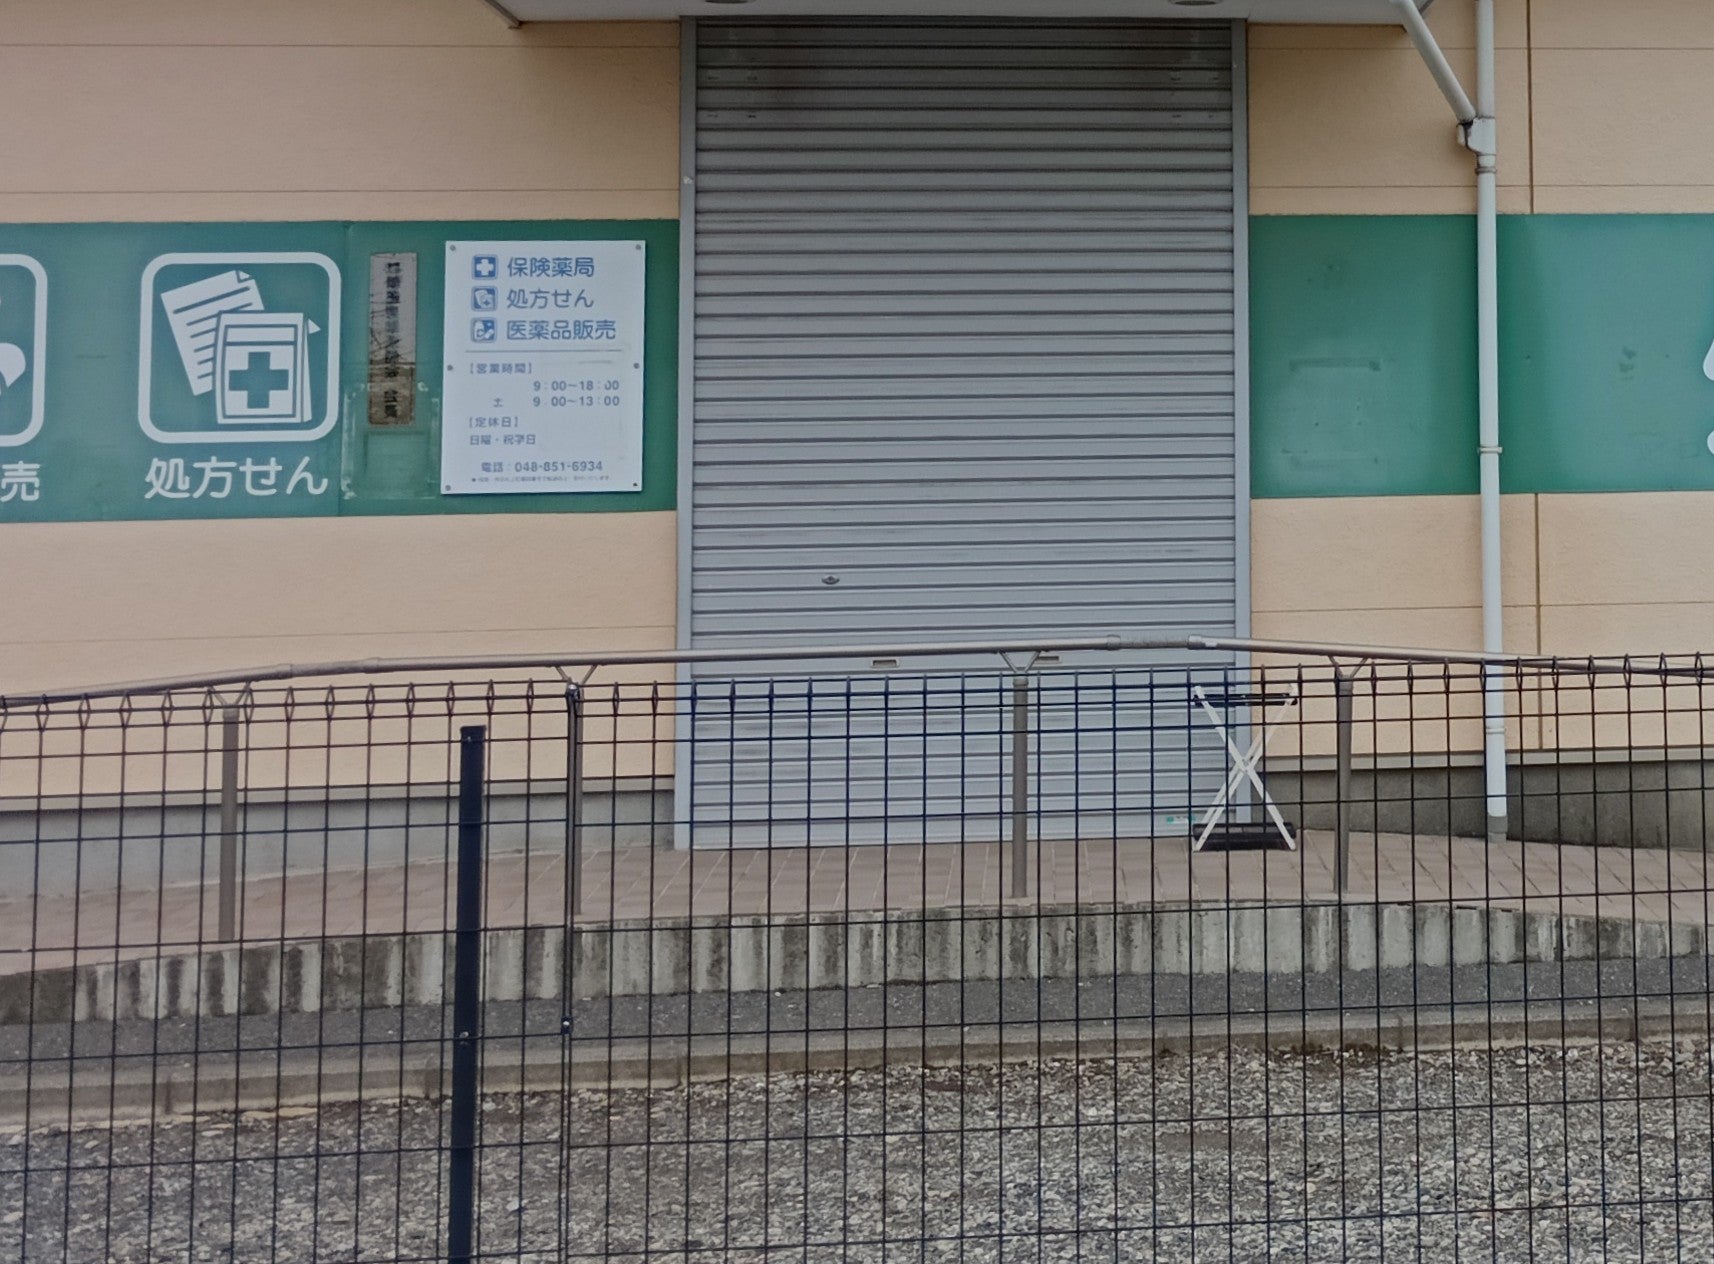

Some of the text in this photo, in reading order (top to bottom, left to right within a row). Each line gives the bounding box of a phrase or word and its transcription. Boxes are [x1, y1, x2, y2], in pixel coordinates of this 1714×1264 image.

[507, 256, 595, 278] 保険薬局
[506, 288, 594, 309] 処方せん
[505, 319, 617, 341] 医薬品販売
[0, 460, 42, 502] 売
[144, 456, 329, 499] 処方せん
